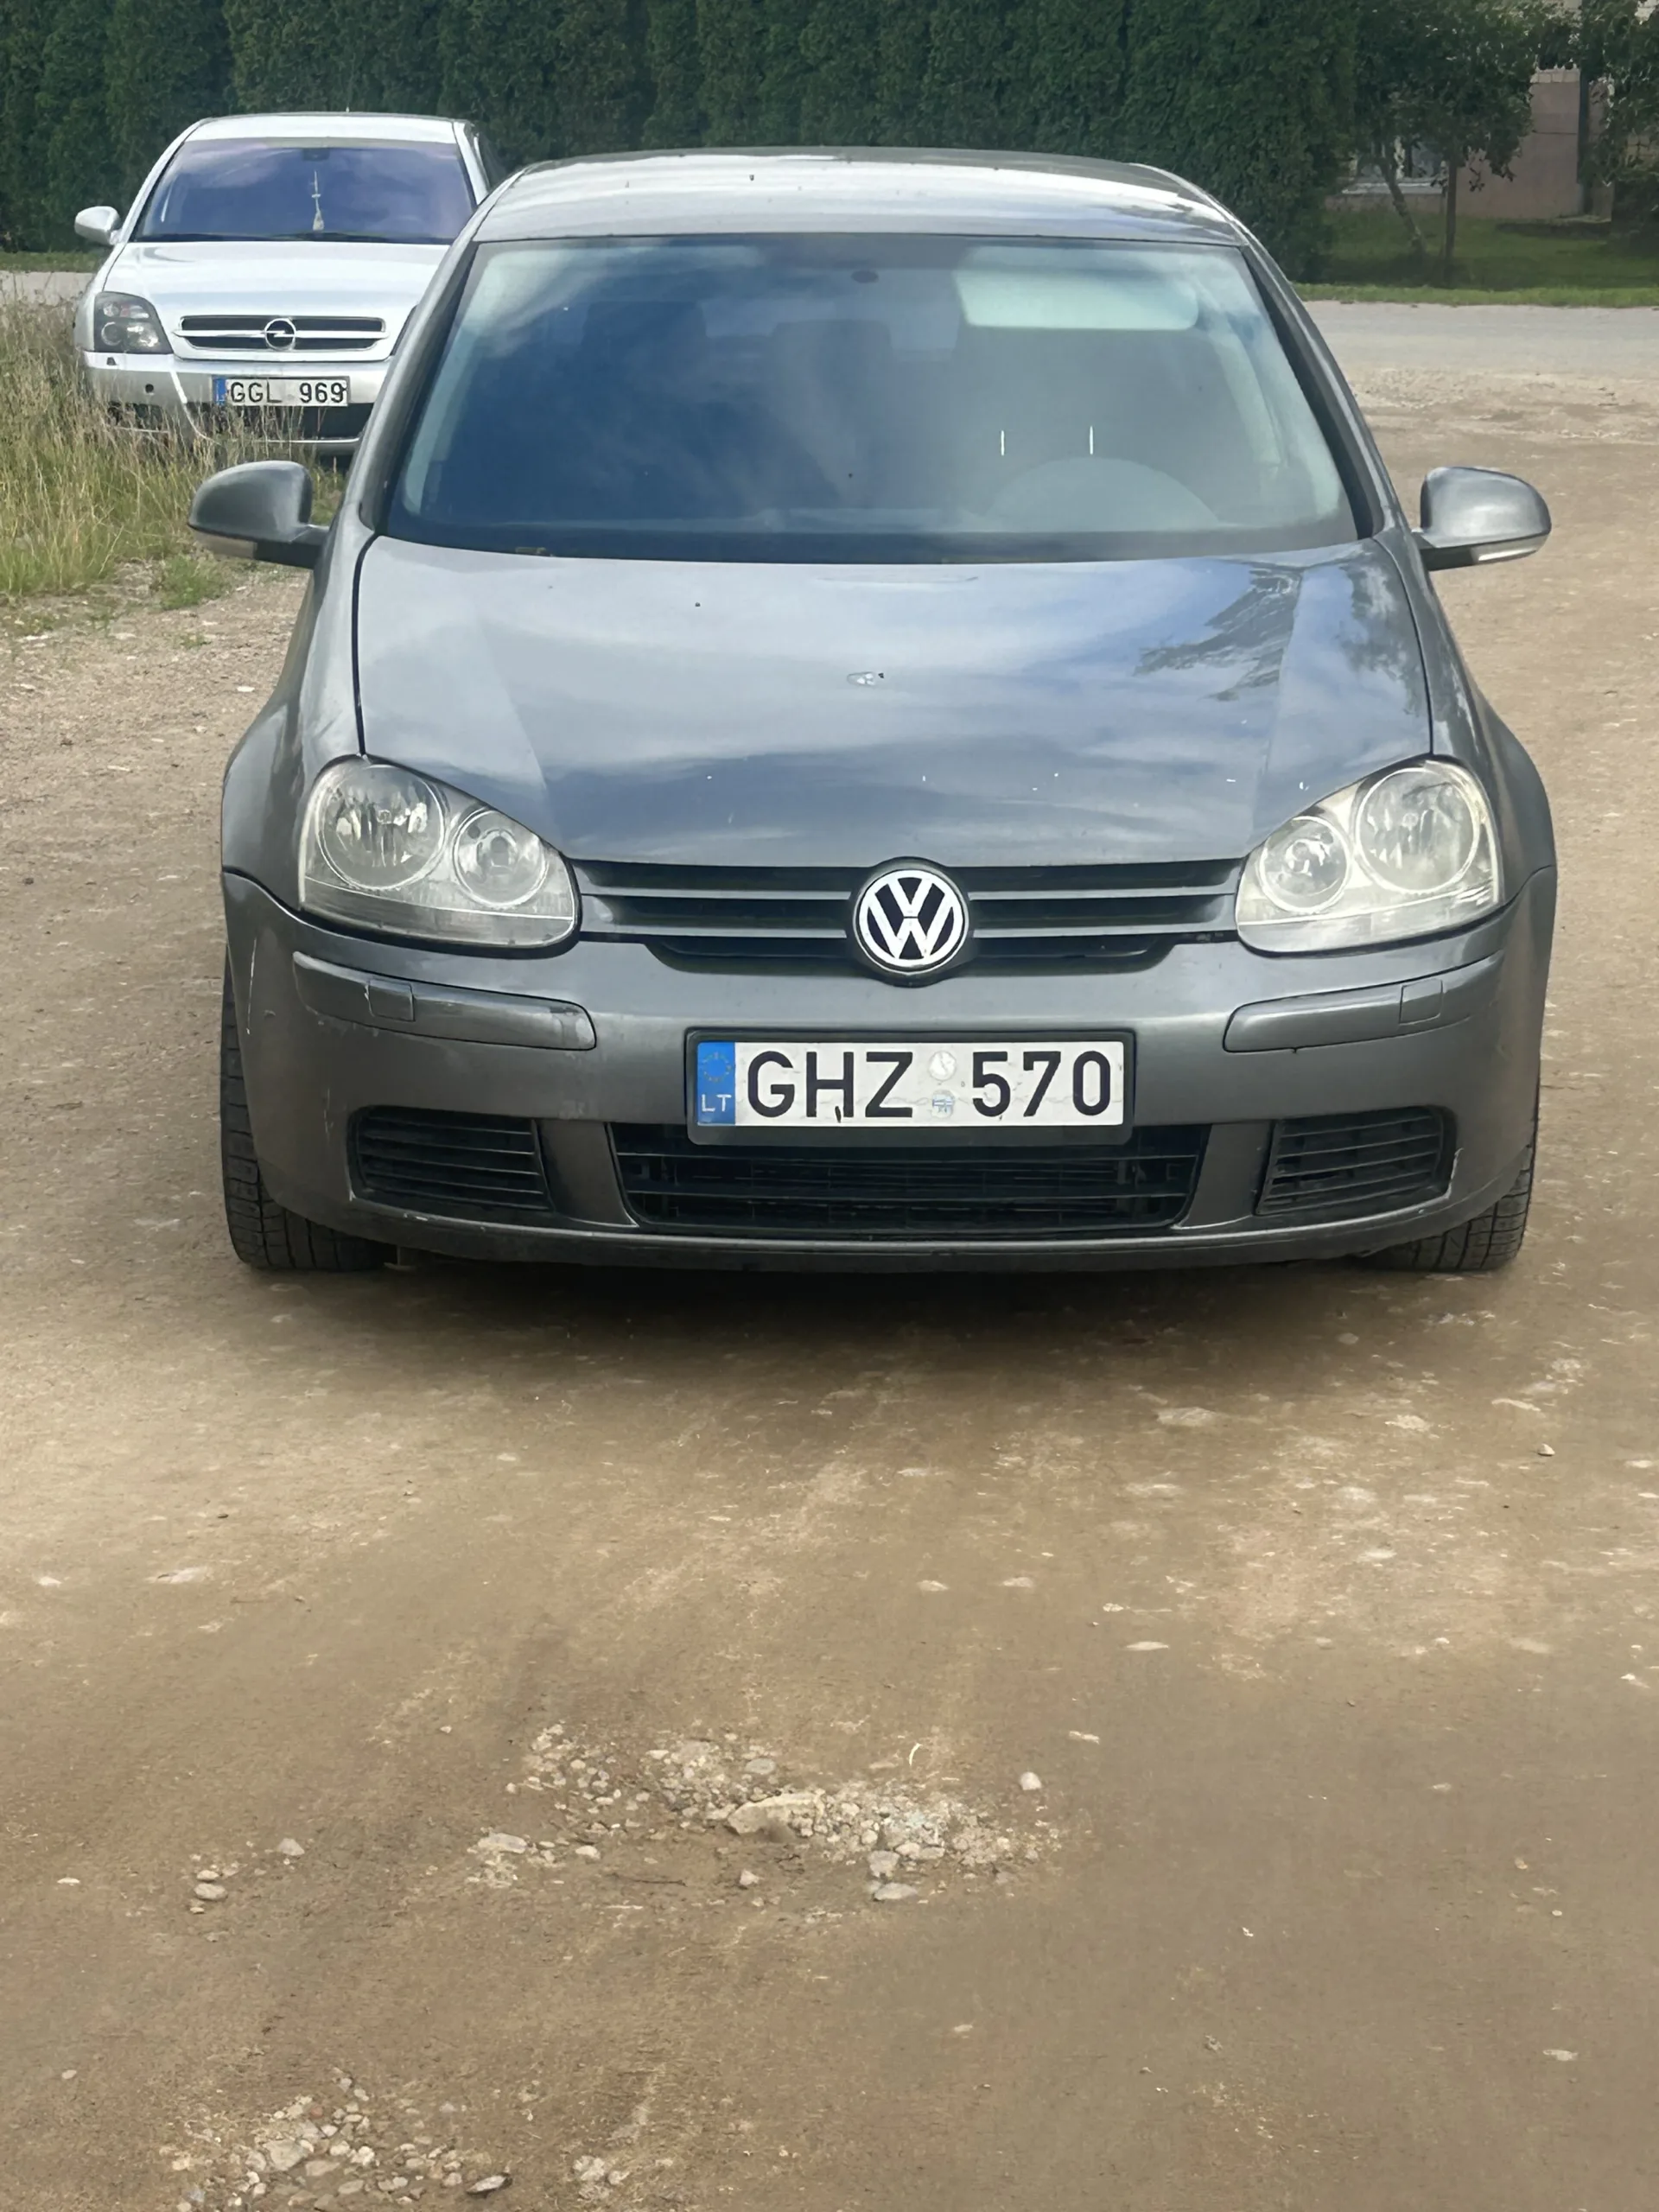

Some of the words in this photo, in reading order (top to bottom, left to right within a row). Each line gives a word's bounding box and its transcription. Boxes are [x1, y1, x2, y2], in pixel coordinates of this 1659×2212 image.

[230, 380, 283, 404] GGL
[299, 382, 344, 404] 969
[859, 869, 963, 968] VW
[701, 1093, 732, 1113] LT
[747, 1050, 913, 1118] GHZ
[972, 1051, 1111, 1118] 570
